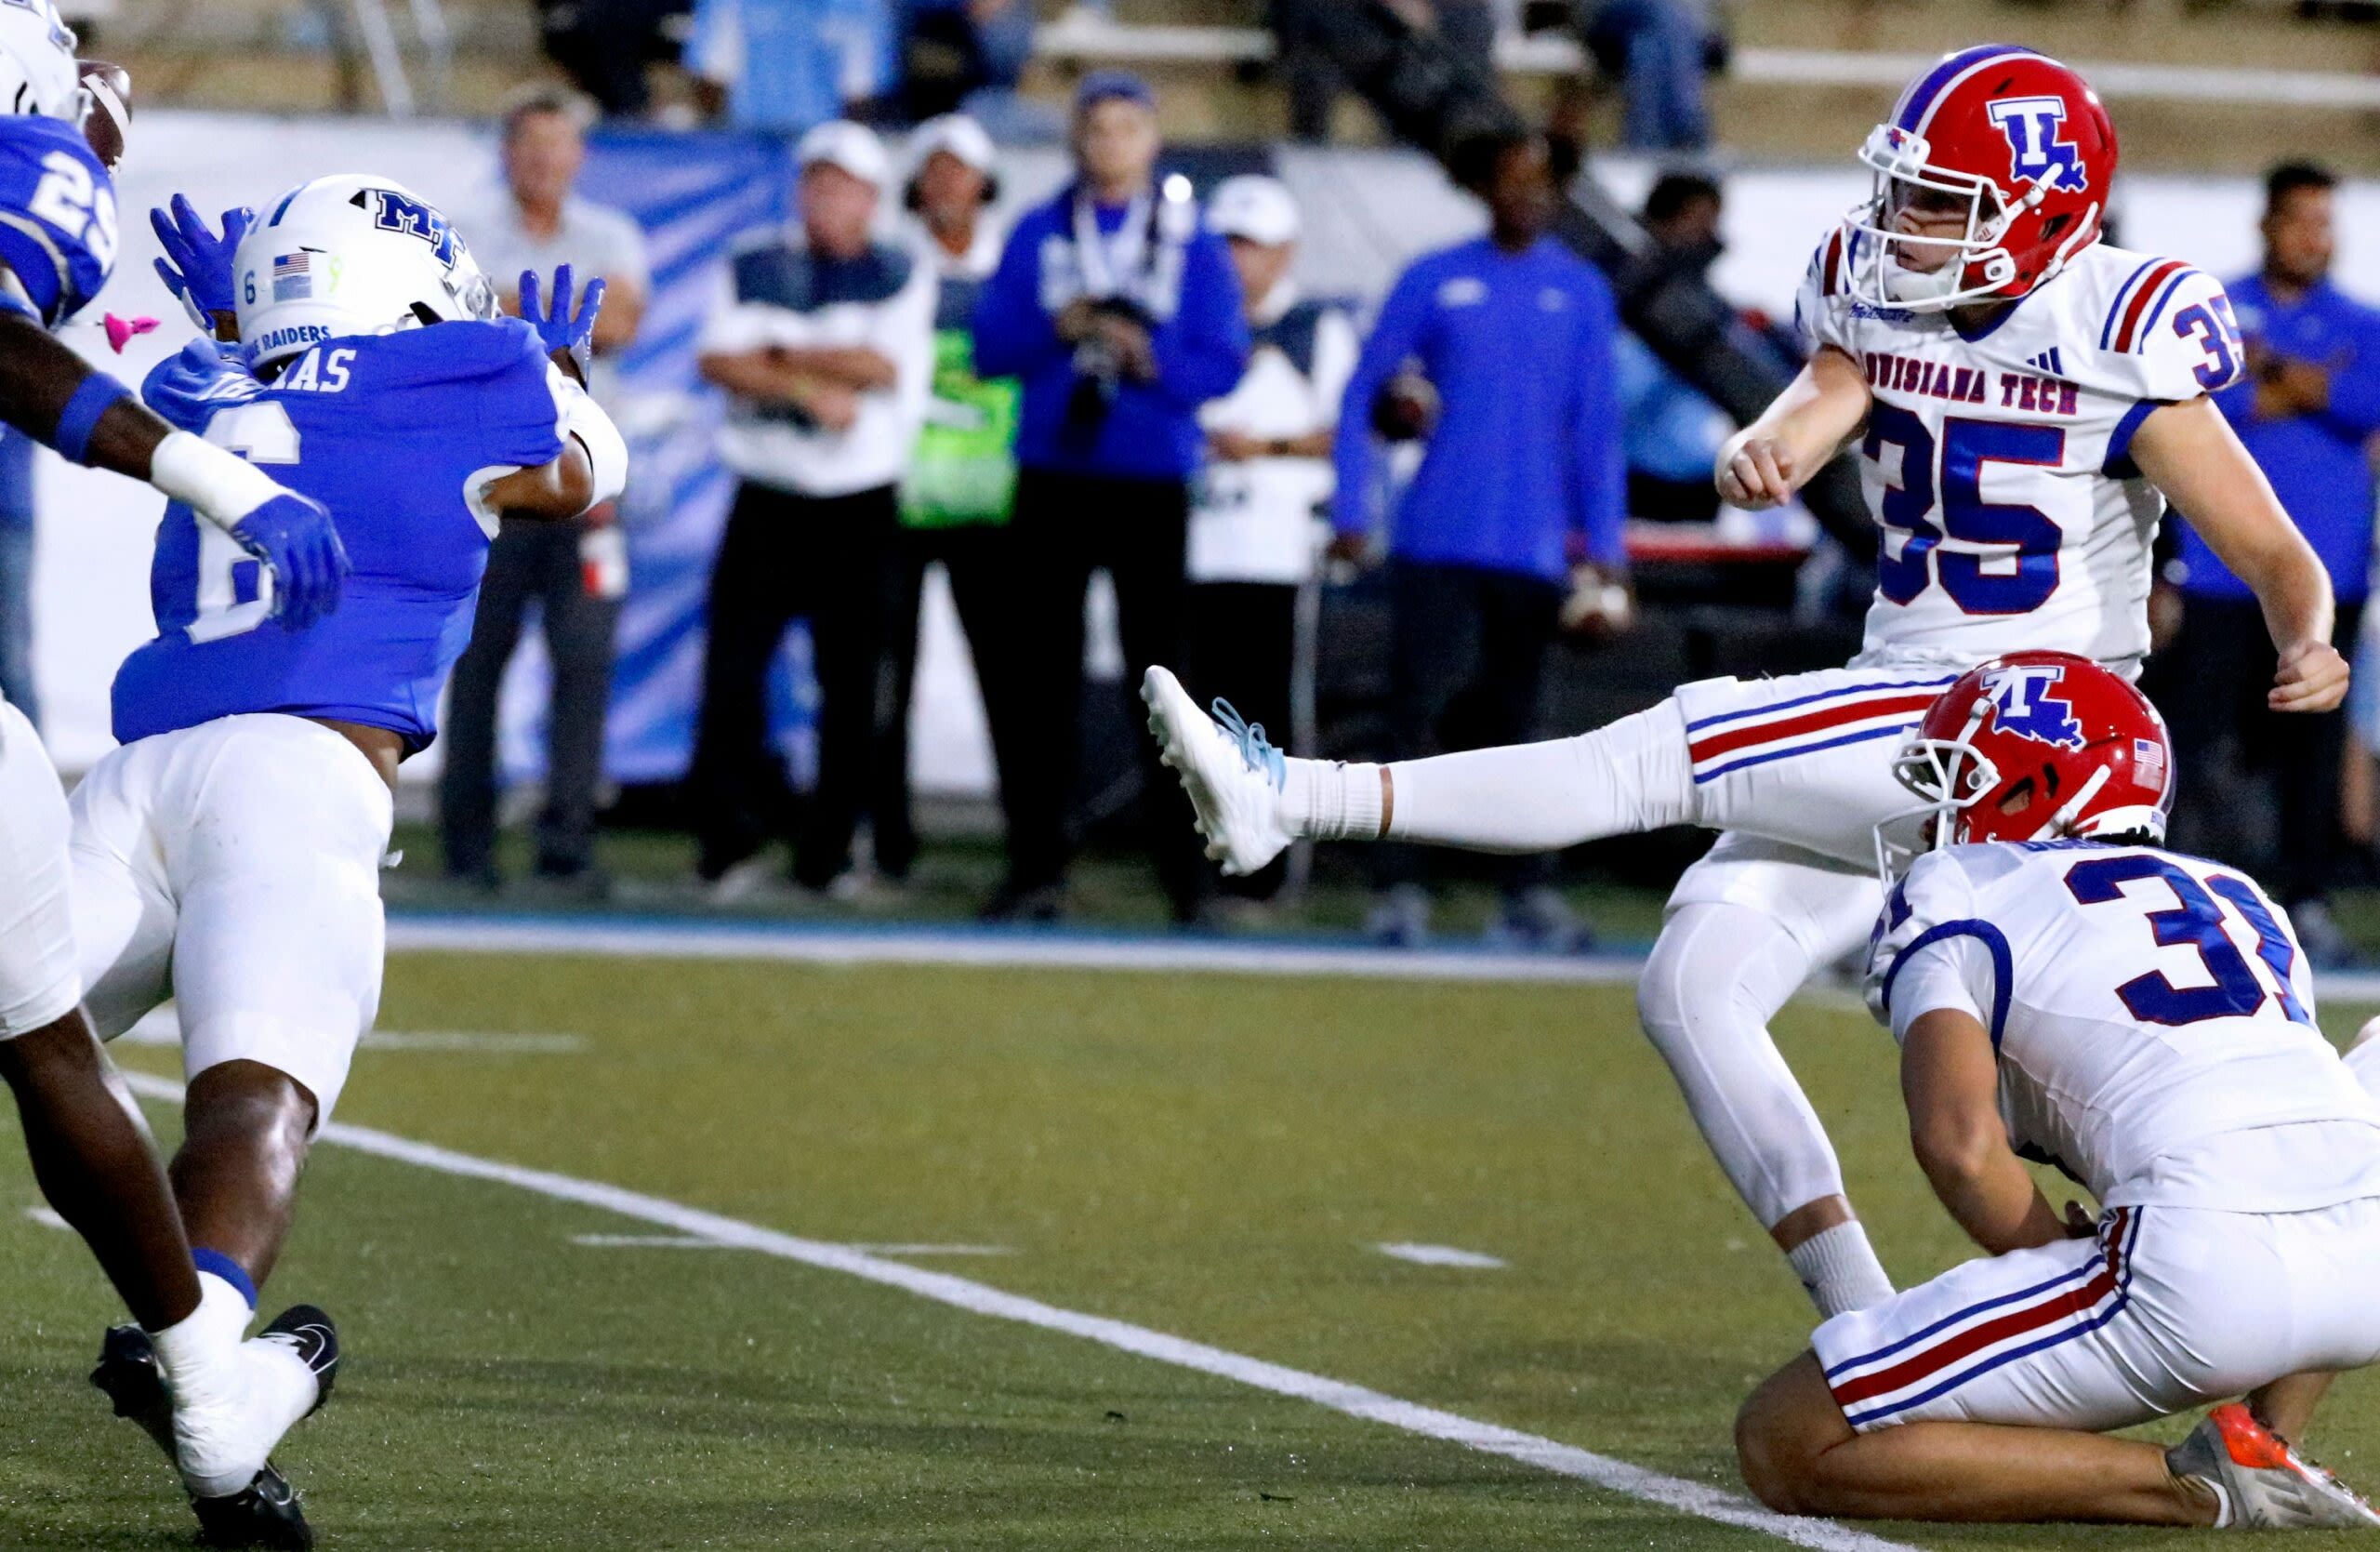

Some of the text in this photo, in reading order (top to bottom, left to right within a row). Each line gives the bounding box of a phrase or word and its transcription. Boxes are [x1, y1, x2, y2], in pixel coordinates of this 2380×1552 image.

[245, 270, 256, 305] 6
[261, 325, 331, 351] RAIDERS
[1864, 352, 2079, 416] OUISIANA TECH
[1863, 400, 2066, 616] 35
[2063, 855, 2310, 1027] 31
